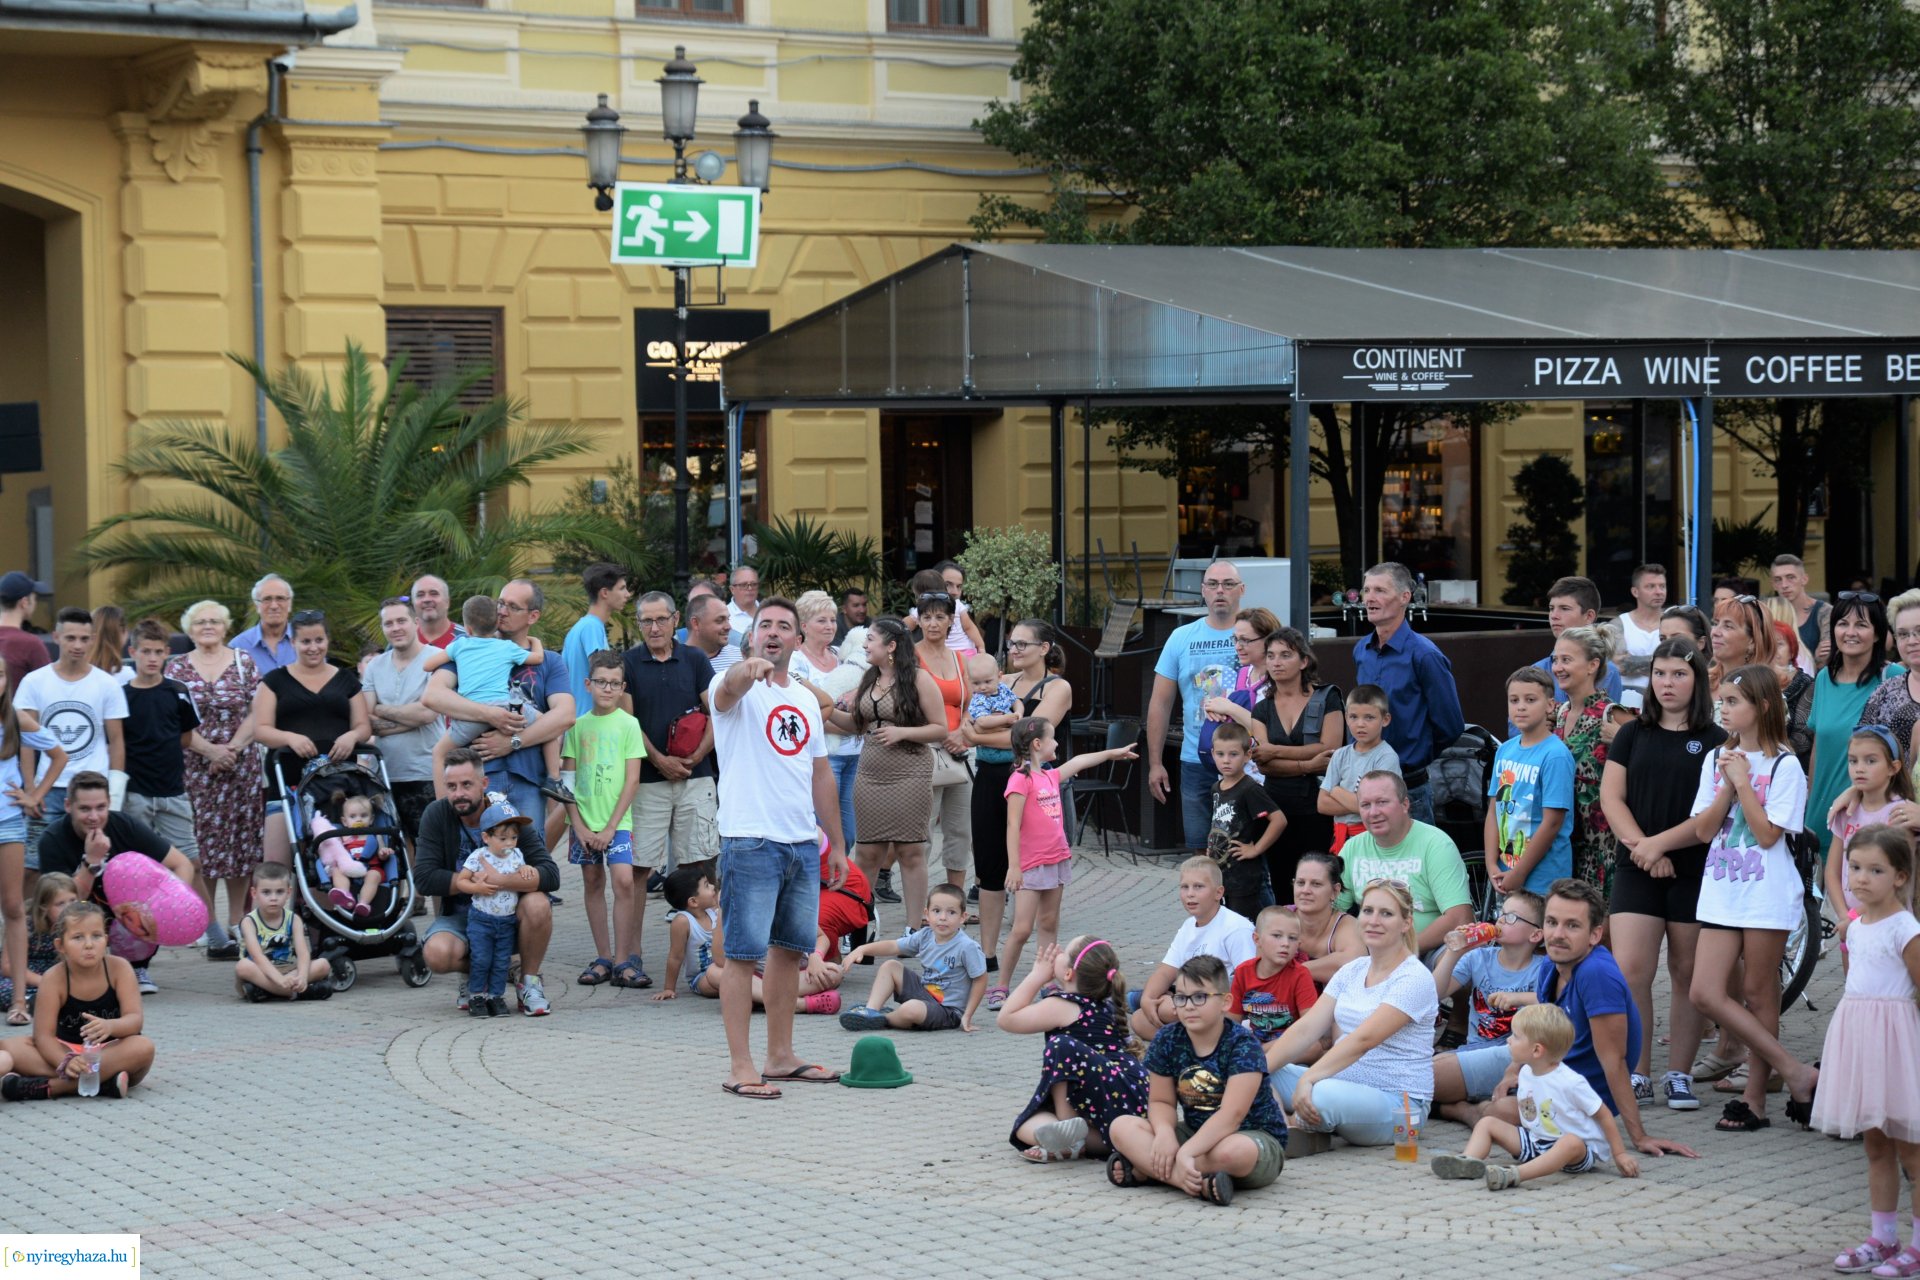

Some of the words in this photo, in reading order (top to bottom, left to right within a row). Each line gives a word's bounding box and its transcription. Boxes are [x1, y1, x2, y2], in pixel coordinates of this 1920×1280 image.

[1352, 348, 1466, 369] CONTINENT
[1374, 372, 1398, 381] WINE
[1401, 372, 1409, 381] &
[1411, 371, 1445, 381] COFFEE
[1534, 357, 1622, 385] PIZZA
[1643, 356, 1720, 384] WINE
[1745, 355, 1863, 384] COFFEE
